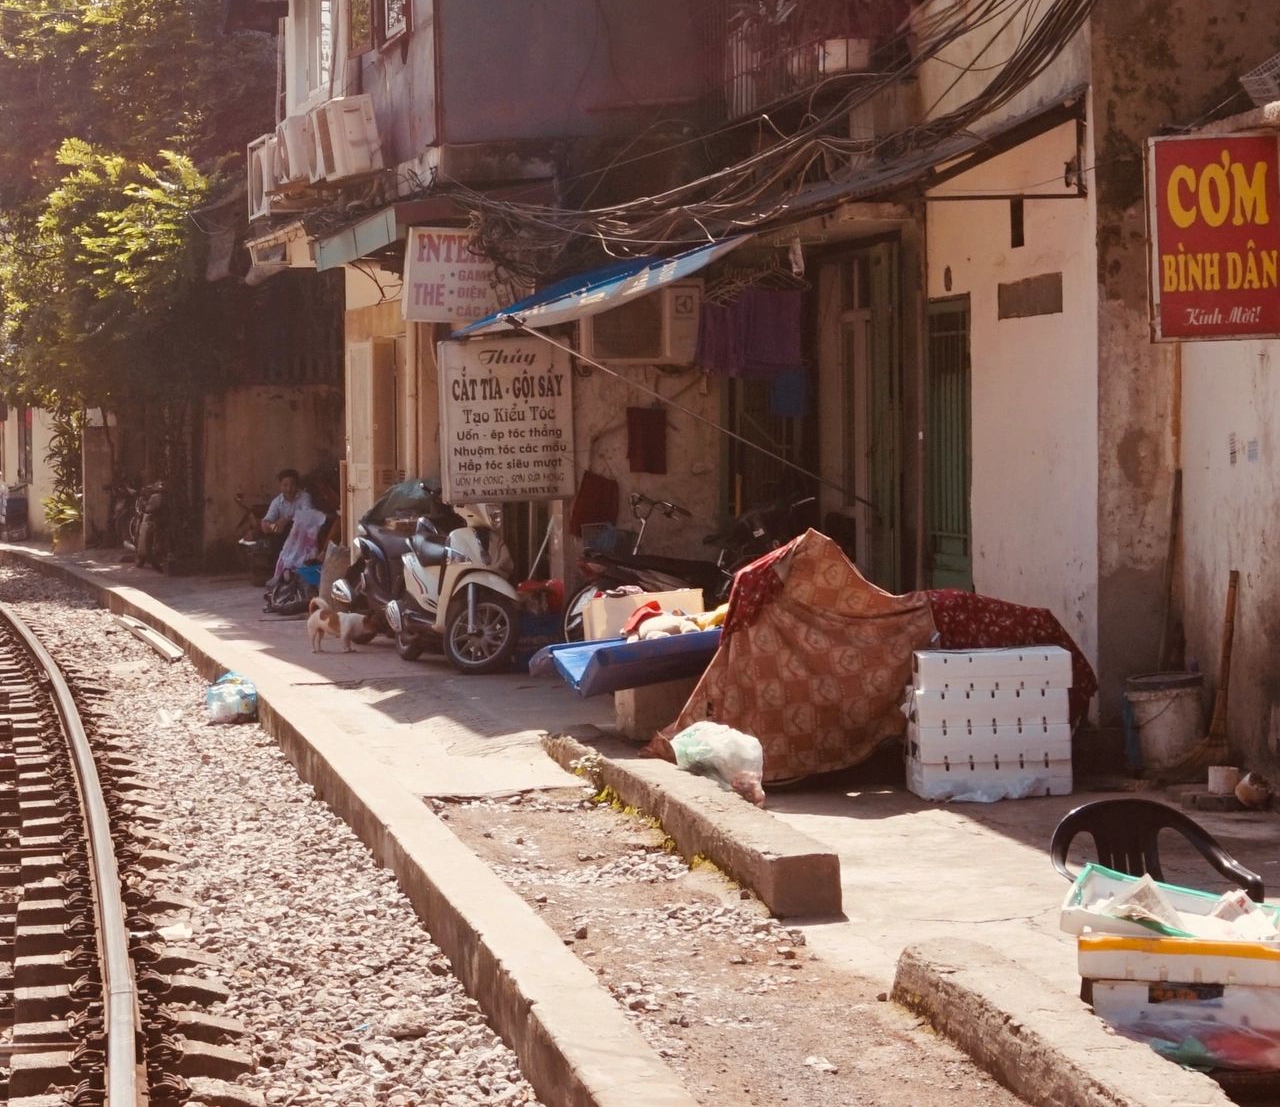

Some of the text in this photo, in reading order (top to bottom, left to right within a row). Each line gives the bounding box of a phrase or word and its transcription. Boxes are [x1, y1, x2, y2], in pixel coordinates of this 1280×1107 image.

[1167, 149, 1270, 228] CƠM
[1162, 239, 1278, 293] BÌNH DÂN
[1183, 308, 1222, 326] Kính
[452, 366, 477, 401] CẮT
[512, 369, 535, 404] GỘI
[538, 363, 563, 398] SẤY
[462, 403, 556, 427] Tạo Kiểu Tóc
[456, 428, 480, 441] Uốn
[453, 445, 495, 458] Nhuộm
